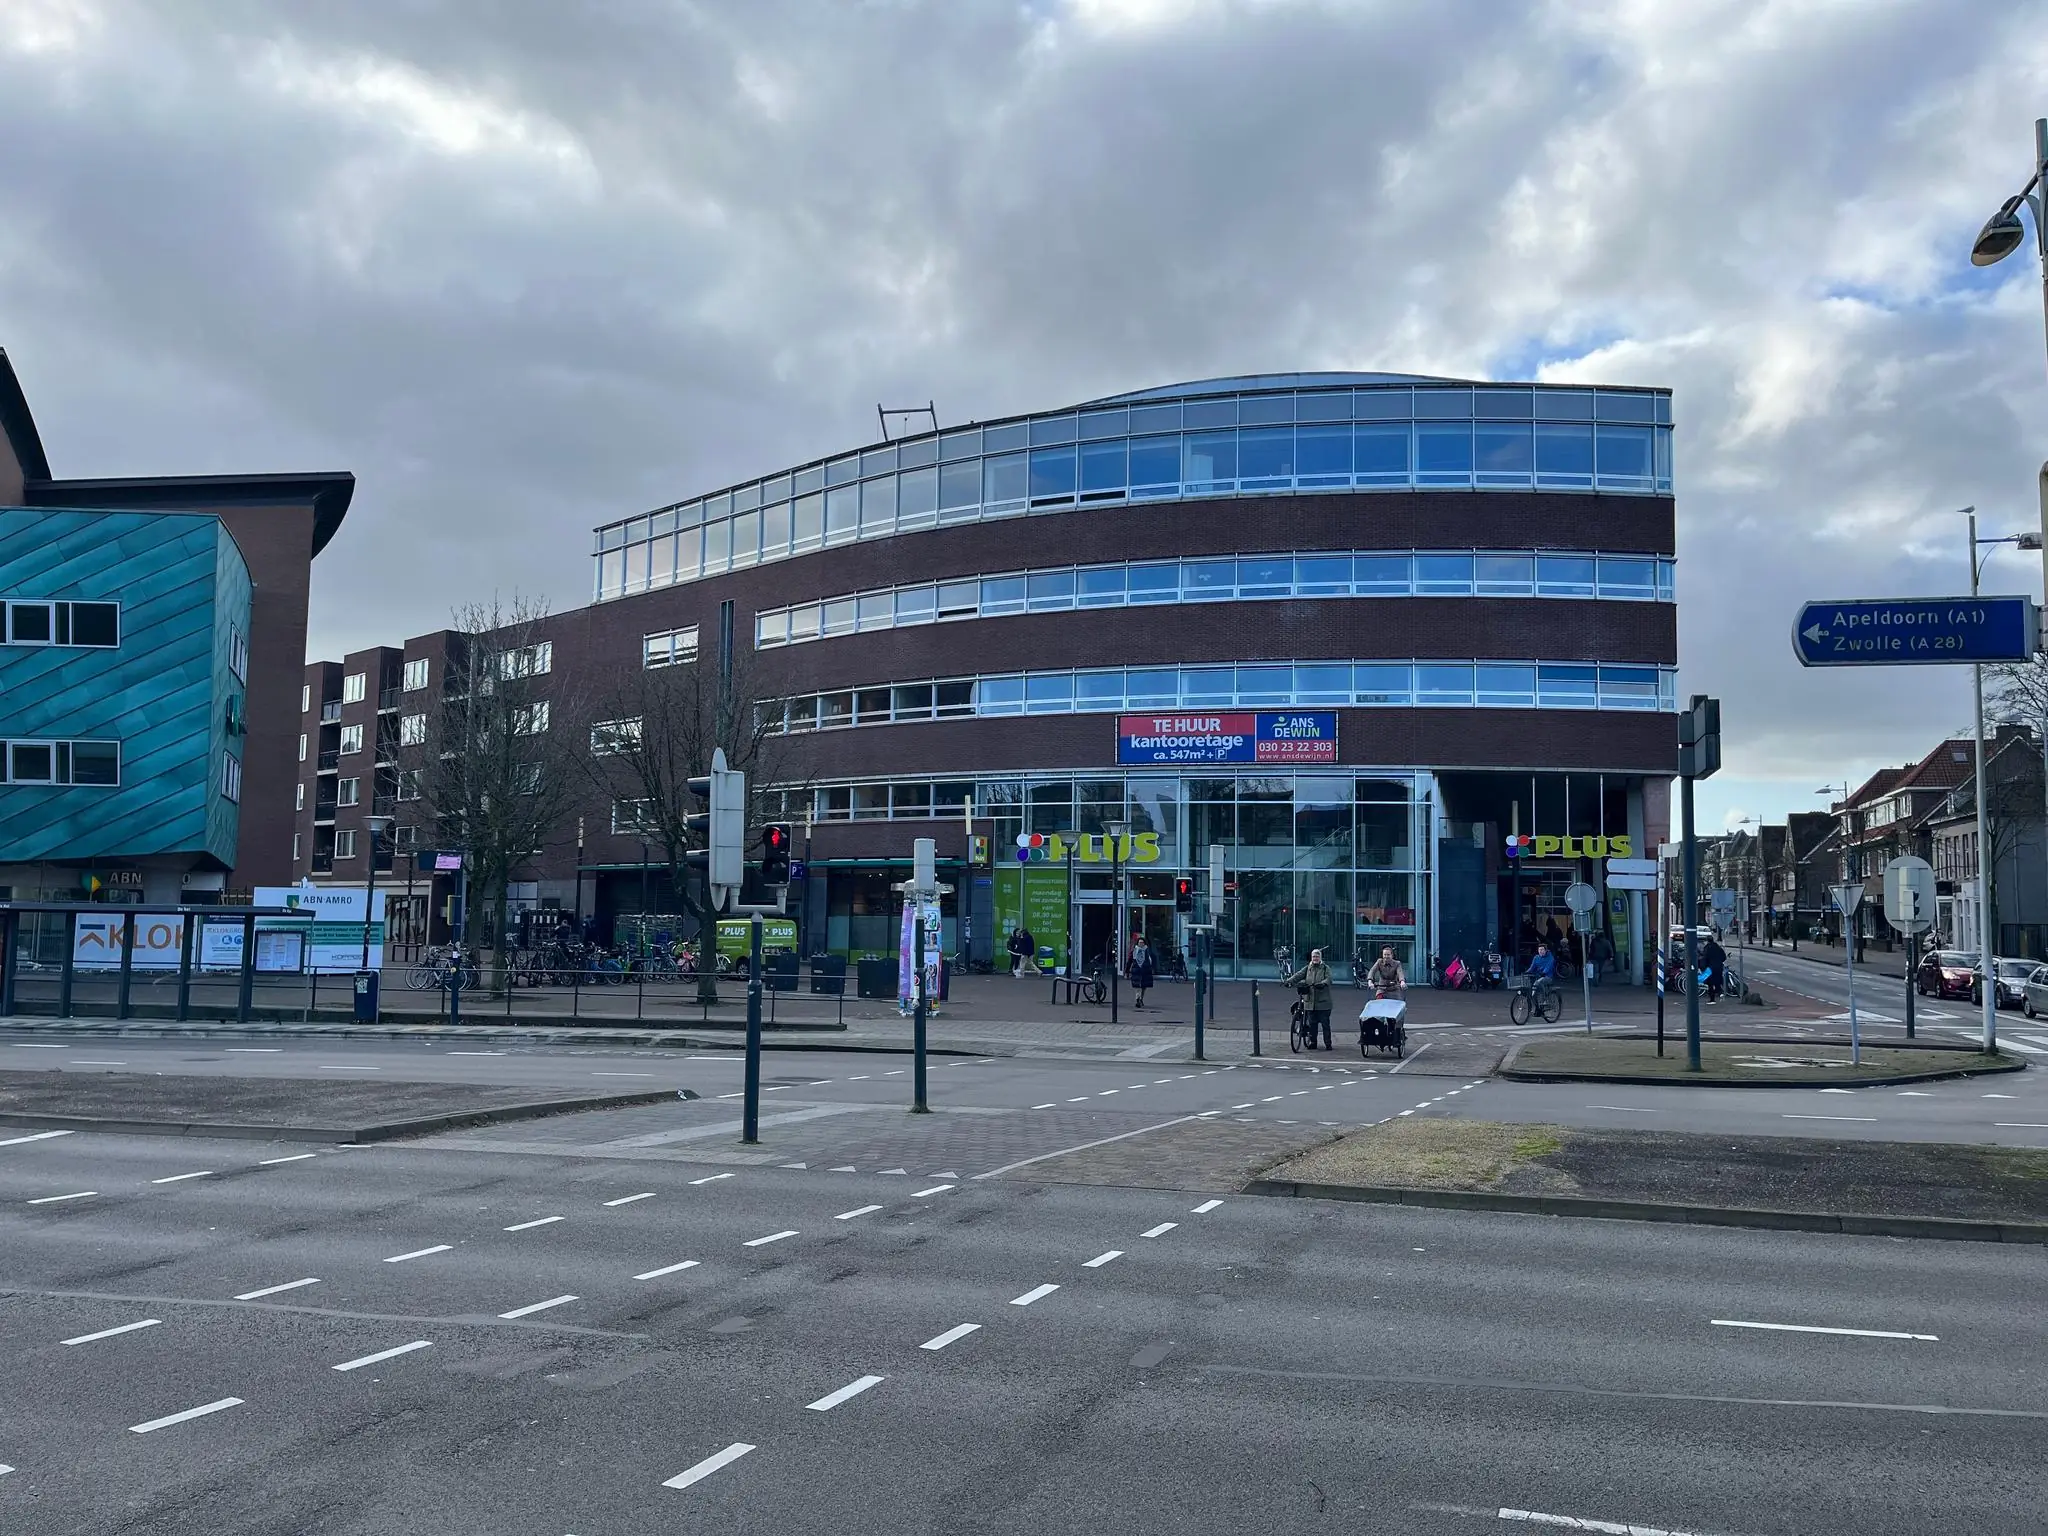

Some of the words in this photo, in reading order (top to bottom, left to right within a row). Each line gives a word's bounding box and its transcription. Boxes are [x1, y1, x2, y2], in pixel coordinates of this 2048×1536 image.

[1832, 611, 1939, 628] Apeldoorn
[1833, 636, 1902, 651] Zwolle
[1152, 719, 1172, 733] TE
[1174, 718, 1221, 732] HUUR
[1290, 717, 1315, 728] ANS
[1130, 733, 1244, 750] kantooretage
[1258, 742, 1278, 752] 030
[1281, 742, 1294, 752] 23
[1296, 742, 1310, 751] 22
[1313, 742, 1332, 751] 303
[1153, 752, 1169, 760] ca.
[1170, 749, 1205, 760] 547m²
[1258, 752, 1333, 761] www.ansdewijn.nl
[1050, 832, 1160, 863] PLUS
[1535, 835, 1633, 859] PLUS
[109, 871, 142, 885] ABN
[724, 927, 746, 936] PLUS
[771, 927, 794, 936] PLUS
